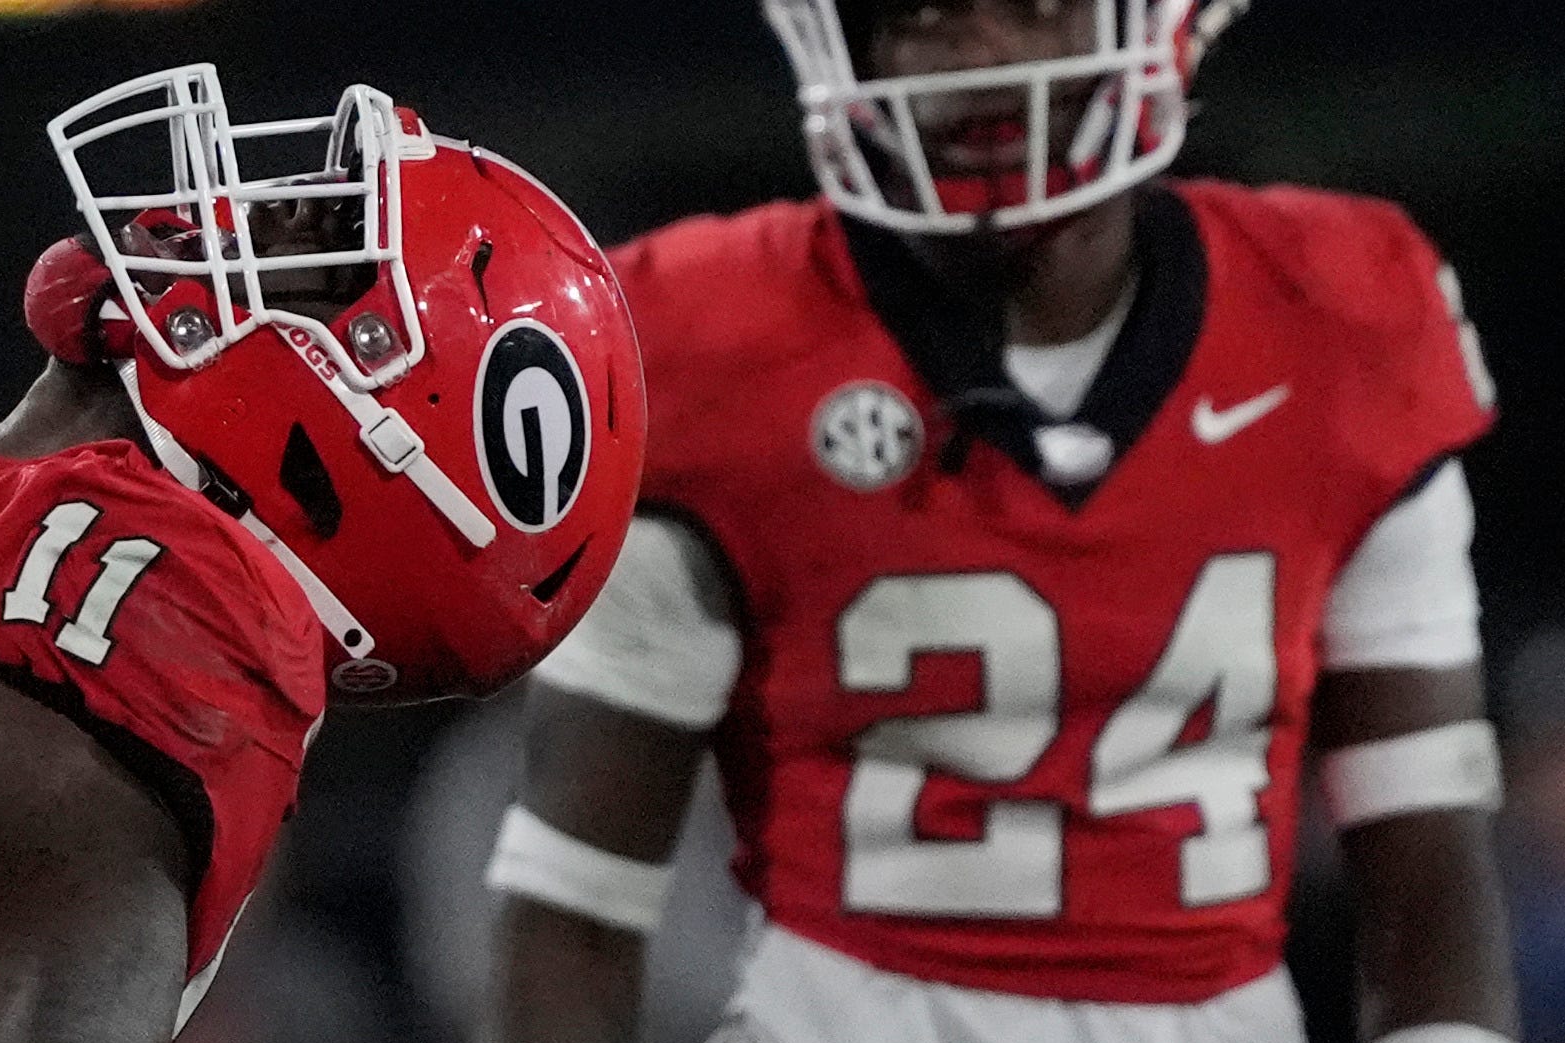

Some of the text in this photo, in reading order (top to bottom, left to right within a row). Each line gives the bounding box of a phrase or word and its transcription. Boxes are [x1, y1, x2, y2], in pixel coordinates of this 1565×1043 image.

[479, 325, 588, 528] G
[1, 500, 165, 666] 11
[840, 551, 1278, 918] 24
